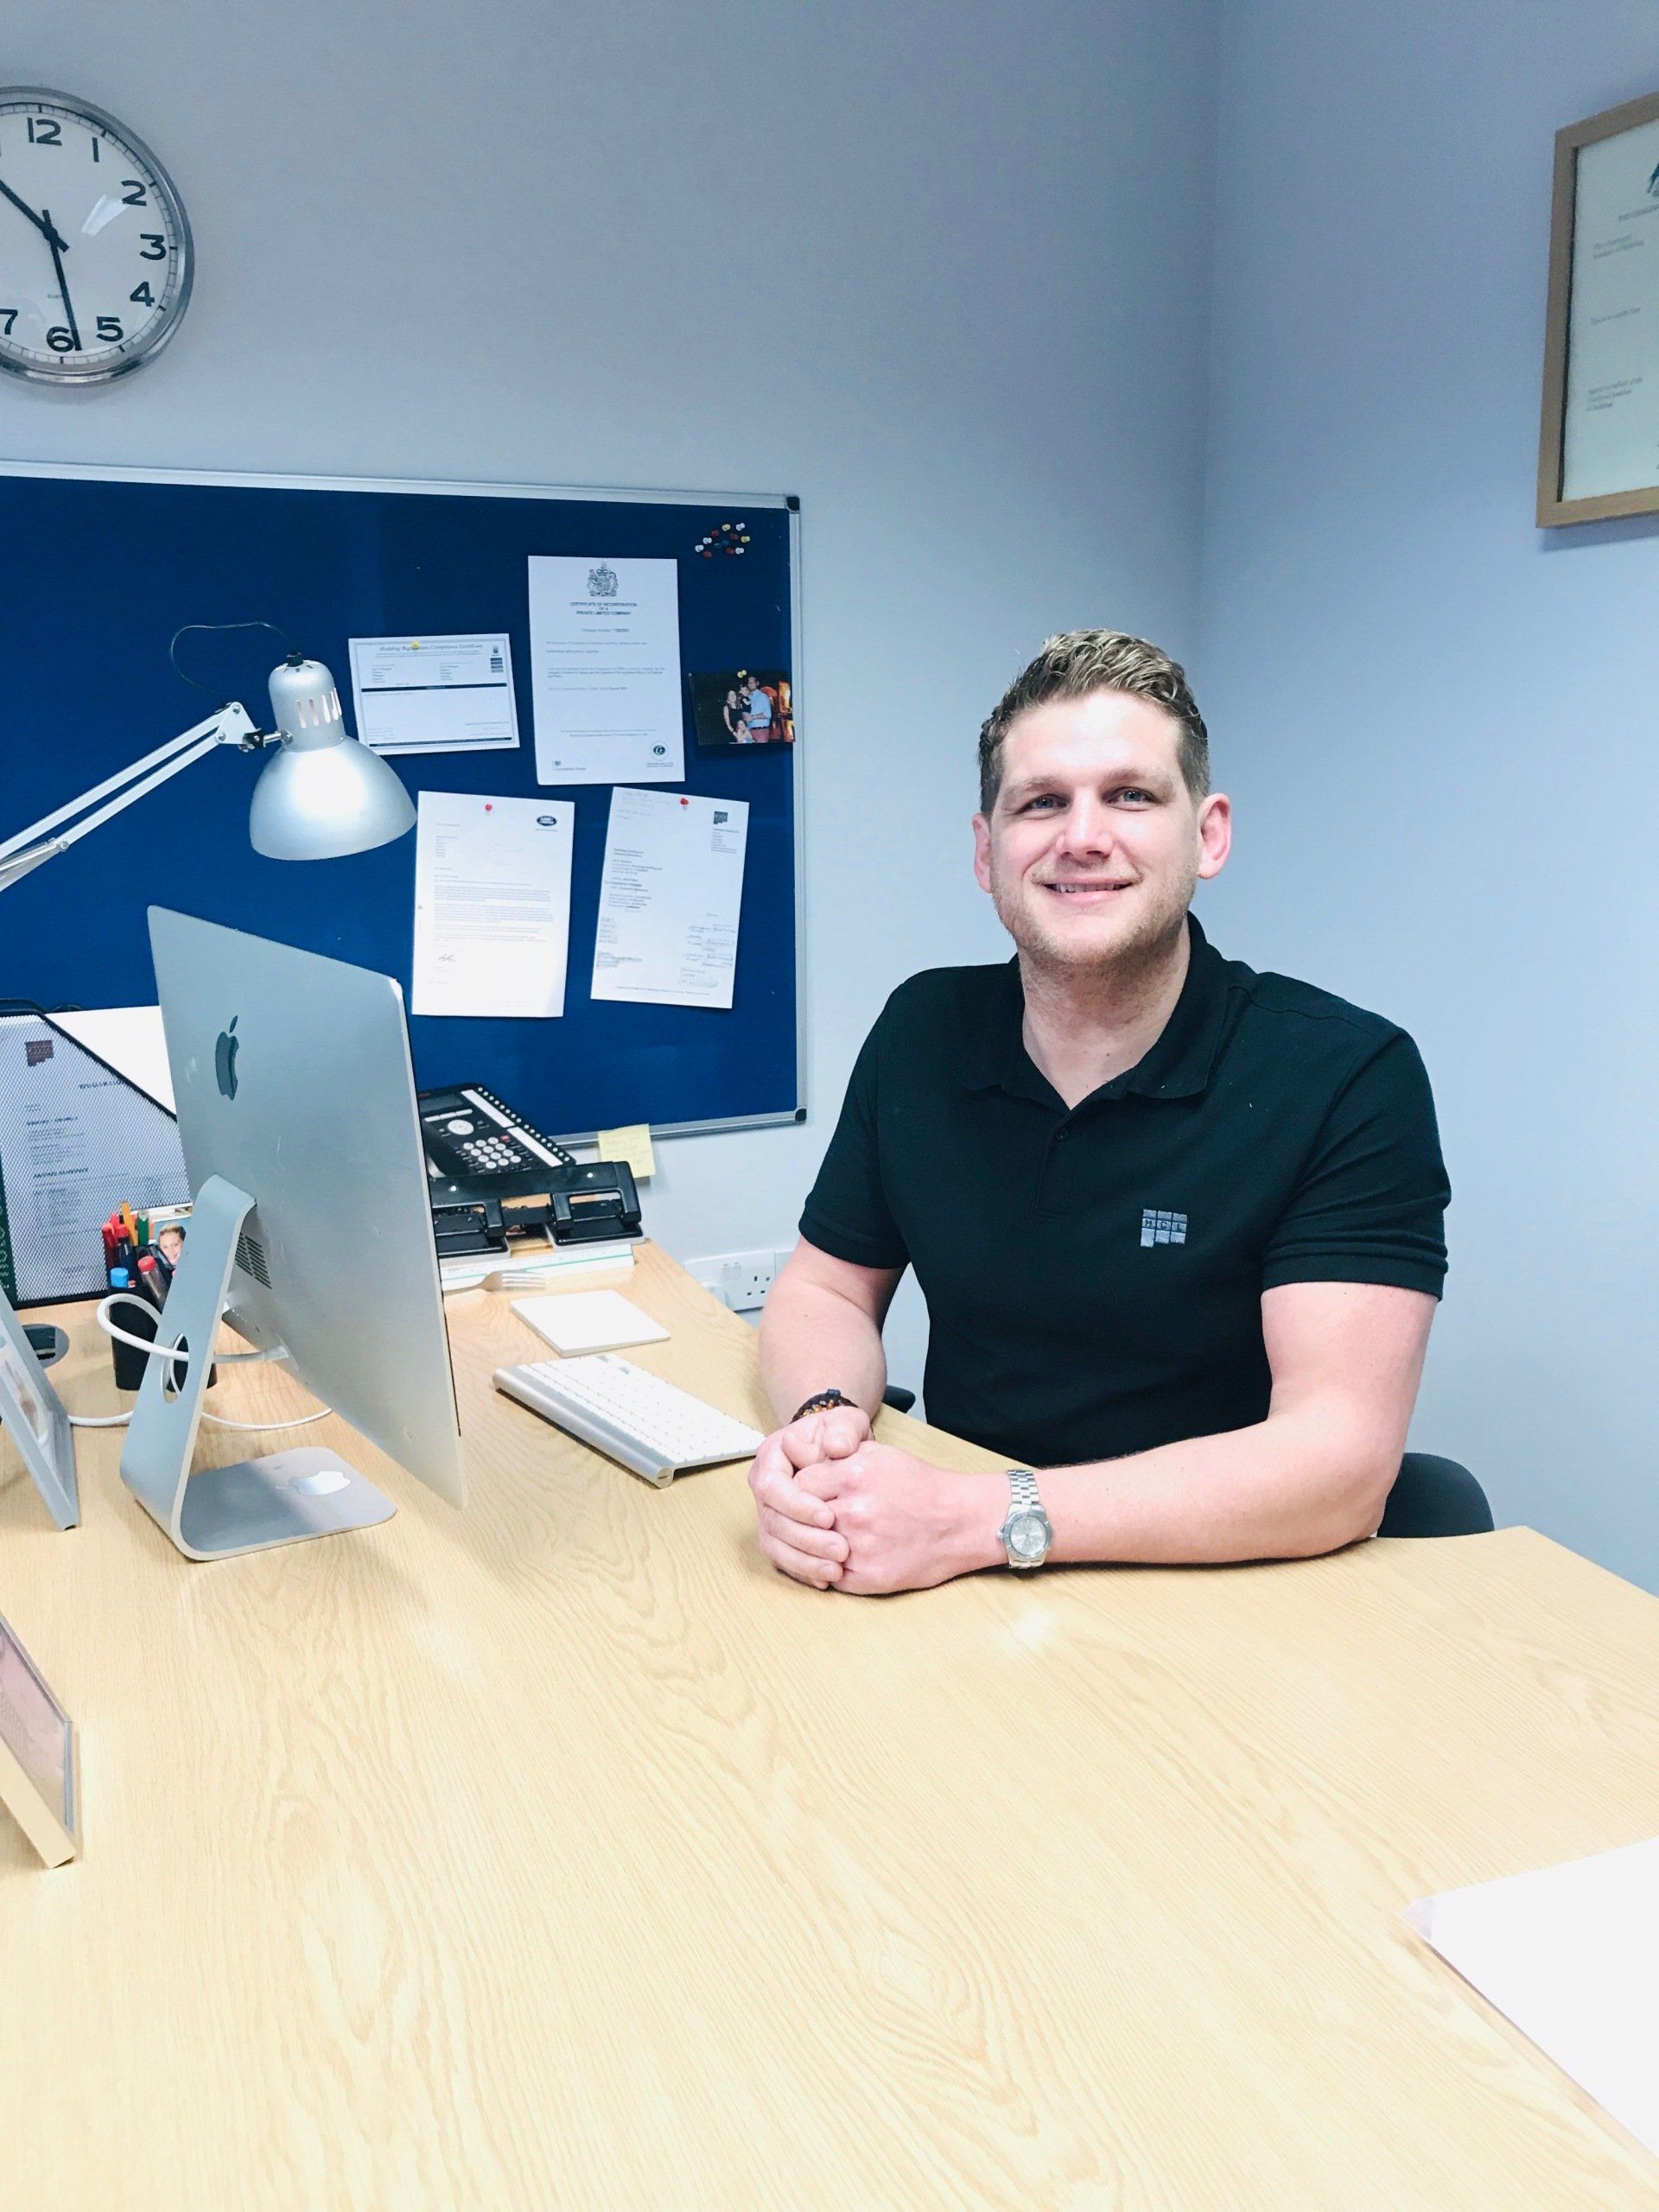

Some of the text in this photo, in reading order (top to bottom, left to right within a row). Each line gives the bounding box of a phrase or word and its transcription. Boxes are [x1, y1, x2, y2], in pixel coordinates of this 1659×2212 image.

[27, 117, 62, 146] 12
[92, 137, 99, 162] 1
[121, 180, 147, 207] 2
[139, 233, 167, 261] 3
[130, 281, 156, 307] 4
[0, 308, 18, 335] 7
[96, 315, 124, 342] 5
[47, 326, 74, 353] 6
